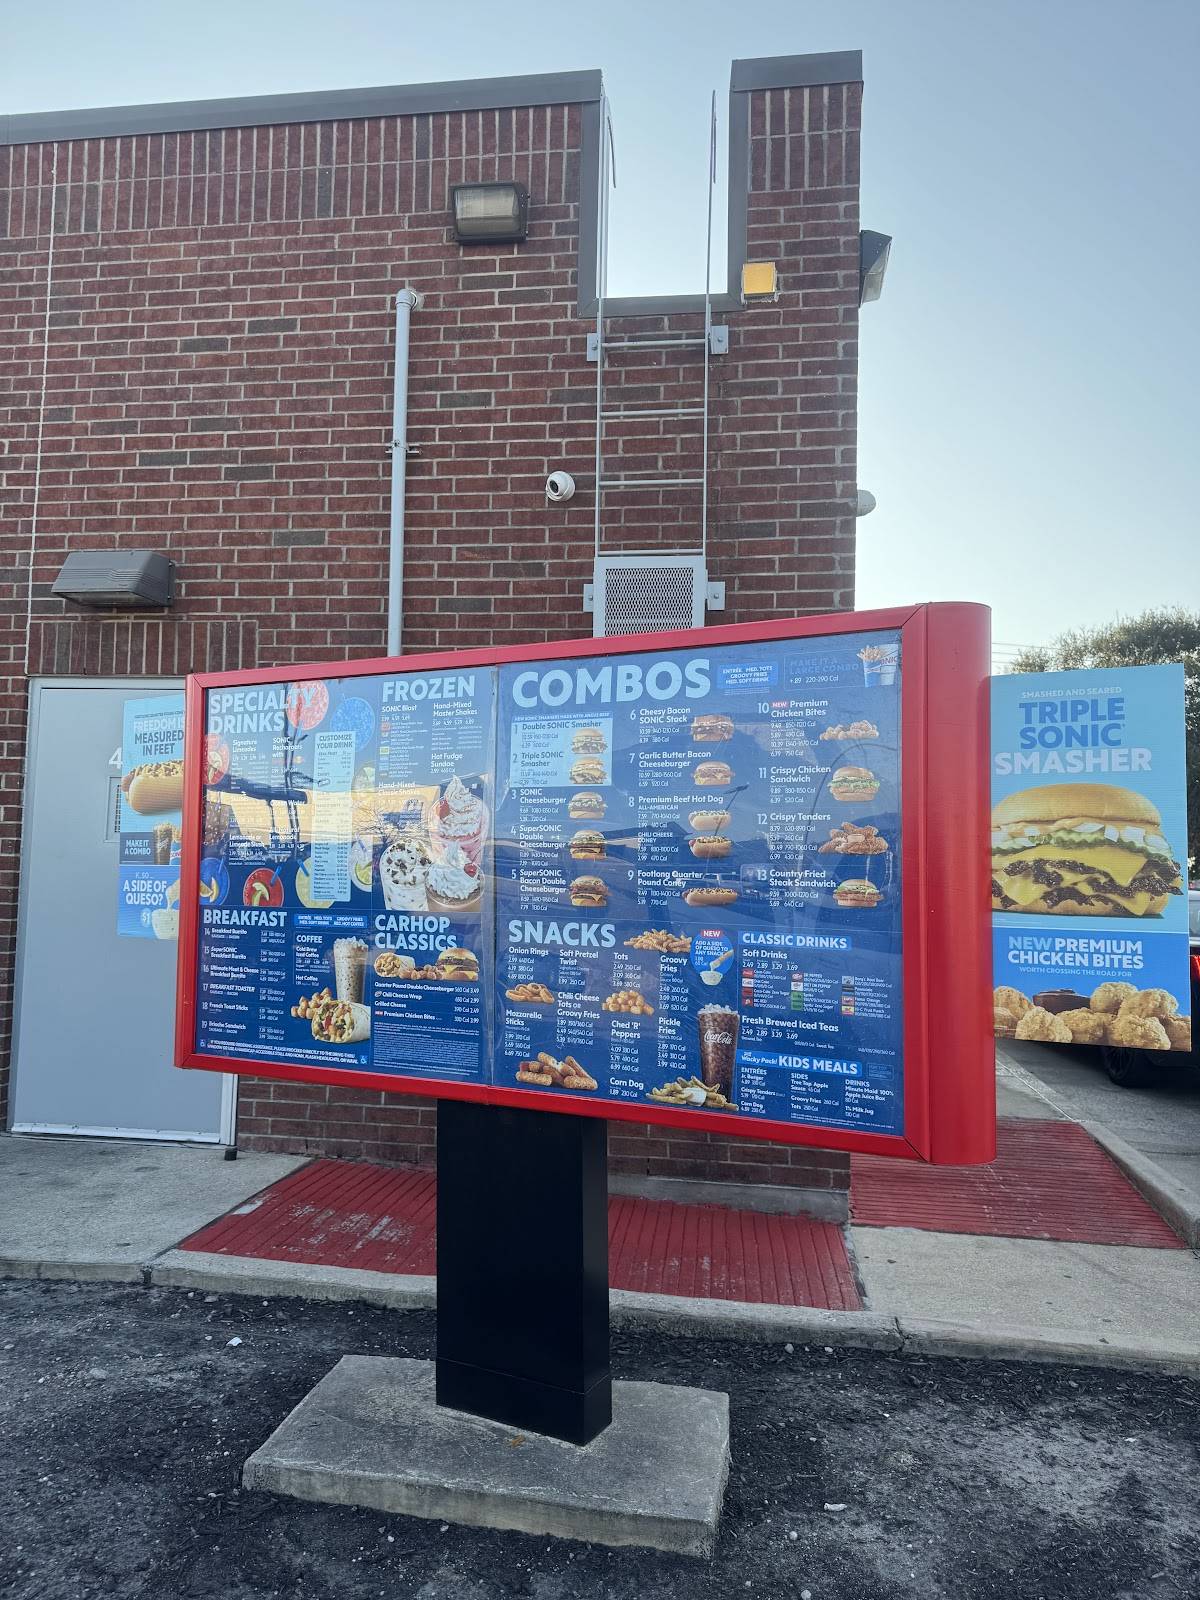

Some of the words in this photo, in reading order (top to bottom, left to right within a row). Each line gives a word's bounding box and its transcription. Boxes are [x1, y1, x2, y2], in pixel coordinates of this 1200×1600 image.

[512, 658, 711, 708] COMBOS
[382, 675, 475, 703] FROZEN
[1022, 689, 1064, 699] SMASHED
[1066, 688, 1086, 697] AND
[1087, 686, 1122, 696] SEARED
[209, 687, 316, 714] SPECIALTY
[433, 701, 472, 711] Hand-Mixed
[455, 708, 478, 716] Shakes
[758, 702, 769, 714] 10
[790, 699, 828, 708] Premium
[1019, 697, 1126, 725] TRIPLE
[630, 710, 636, 720] 6
[640, 708, 665, 717] Cheesy
[771, 709, 803, 718] Chicken
[805, 708, 827, 717] Bites
[209, 711, 285, 734] DRINKS
[640, 716, 664, 724] SONIC
[667, 715, 688, 723] Stack
[134, 718, 177, 733] FREEDOM
[514, 725, 518, 735] 1
[522, 722, 546, 731] Double
[547, 721, 569, 730] SONIC
[571, 720, 602, 729] Smasher
[134, 730, 184, 745] MEASURED
[1019, 722, 1122, 750] SONIC
[142, 744, 153, 757] IN
[154, 743, 176, 756] FEET
[108, 747, 123, 769] 4
[443, 753, 463, 761] Fudge
[513, 753, 518, 763] 2
[522, 752, 540, 761] Triple
[540, 751, 563, 759] SONIC
[629, 753, 635, 764] 7
[639, 752, 661, 760] Garlic
[662, 751, 685, 759] Butter
[994, 748, 1152, 775] SMASHER
[431, 760, 455, 768] Sundae
[521, 760, 550, 768] Smasher
[639, 760, 691, 769] Cheeseburger
[758, 767, 767, 779] 11
[770, 767, 796, 776] Crispy
[798, 766, 831, 774] Chicken
[770, 775, 811, 783] Sandwich
[512, 789, 517, 800] 3
[520, 788, 543, 796] SONIC
[520, 796, 567, 805] Cheeseburger
[629, 796, 635, 807] 8
[639, 796, 672, 804] Premium
[692, 795, 706, 803] Hot
[708, 795, 724, 804] Dog
[757, 813, 768, 825] 12
[770, 813, 796, 822] Crispy
[798, 813, 831, 821] Tenders
[511, 825, 516, 835] 4
[520, 825, 562, 834] SuperSONIC
[126, 839, 141, 847] MAKE
[143, 839, 150, 847] IT
[520, 840, 566, 850] Cheeseburger
[512, 869, 517, 880] 5
[520, 869, 562, 878] SuperSONIC
[628, 870, 634, 880] 9
[638, 870, 670, 879] Footlong
[672, 871, 702, 879] Quarter
[757, 869, 767, 881] 13
[770, 870, 803, 880] Country
[804, 870, 826, 878] Fried
[123, 880, 131, 892] A
[131, 880, 153, 892] SIDE
[153, 880, 167, 892] OF
[542, 878, 566, 886] Double
[638, 879, 662, 887] Pound
[663, 879, 687, 888] Coney
[769, 878, 793, 888] Steak
[795, 879, 837, 889] Sandwich
[520, 886, 567, 895] Cheeseburger
[126, 892, 164, 906] QUESO?
[203, 909, 288, 927] BREAKFAST
[374, 914, 451, 933] CARHOP
[296, 935, 323, 944] COFFEE
[508, 920, 616, 948] SNACKS
[703, 930, 720, 938] NEW
[374, 933, 458, 952] CLASSICS
[742, 933, 794, 946] CLASSIC
[796, 935, 848, 949] DRINKS
[1008, 936, 1052, 950] NEW
[1055, 937, 1143, 955] PREMIUM
[508, 946, 529, 955] Onion
[530, 948, 549, 957] Rings
[560, 949, 574, 957] Soft
[575, 951, 599, 959] Pretzel
[613, 952, 629, 961] Tots
[742, 949, 760, 958] Soft
[761, 950, 788, 960] Drinks
[560, 958, 578, 966] Twist
[660, 955, 688, 966] Groovy
[1008, 950, 1089, 967] CHICKEN
[1092, 953, 1144, 970] BITES
[660, 964, 678, 973] Fries
[1019, 966, 1045, 974] WORTH
[1046, 967, 1081, 976] CROSSING
[574, 993, 600, 1002] Cheese
[557, 1000, 572, 1008] Tots
[505, 1009, 542, 1020] Mozzarella
[557, 1009, 582, 1019] Groovy
[583, 1011, 600, 1019] Fries
[505, 1018, 525, 1026] Sticks
[611, 1020, 631, 1029] Ched
[631, 1021, 641, 1030] 'R'
[658, 1017, 681, 1027] Pickle
[742, 1015, 764, 1026] Fresh
[765, 1017, 797, 1029] Brewed
[799, 1020, 818, 1030] Iced
[819, 1022, 839, 1033] Teas
[611, 1029, 641, 1040] Peppers
[658, 1026, 676, 1035] Fries
[742, 1028, 753, 1036] 2.49
[786, 1032, 798, 1040] 3.69
[703, 1030, 733, 1045] Coca-Cola
[741, 1055, 760, 1064] Wacky
[778, 1055, 810, 1069] KIDS
[812, 1059, 858, 1075] MEALS
[741, 1067, 767, 1076] ENTRÉES
[791, 1072, 809, 1080] SIDES
[609, 1076, 628, 1087] Corn
[628, 1078, 644, 1091] Dog
[845, 1079, 870, 1088] DRINKS
